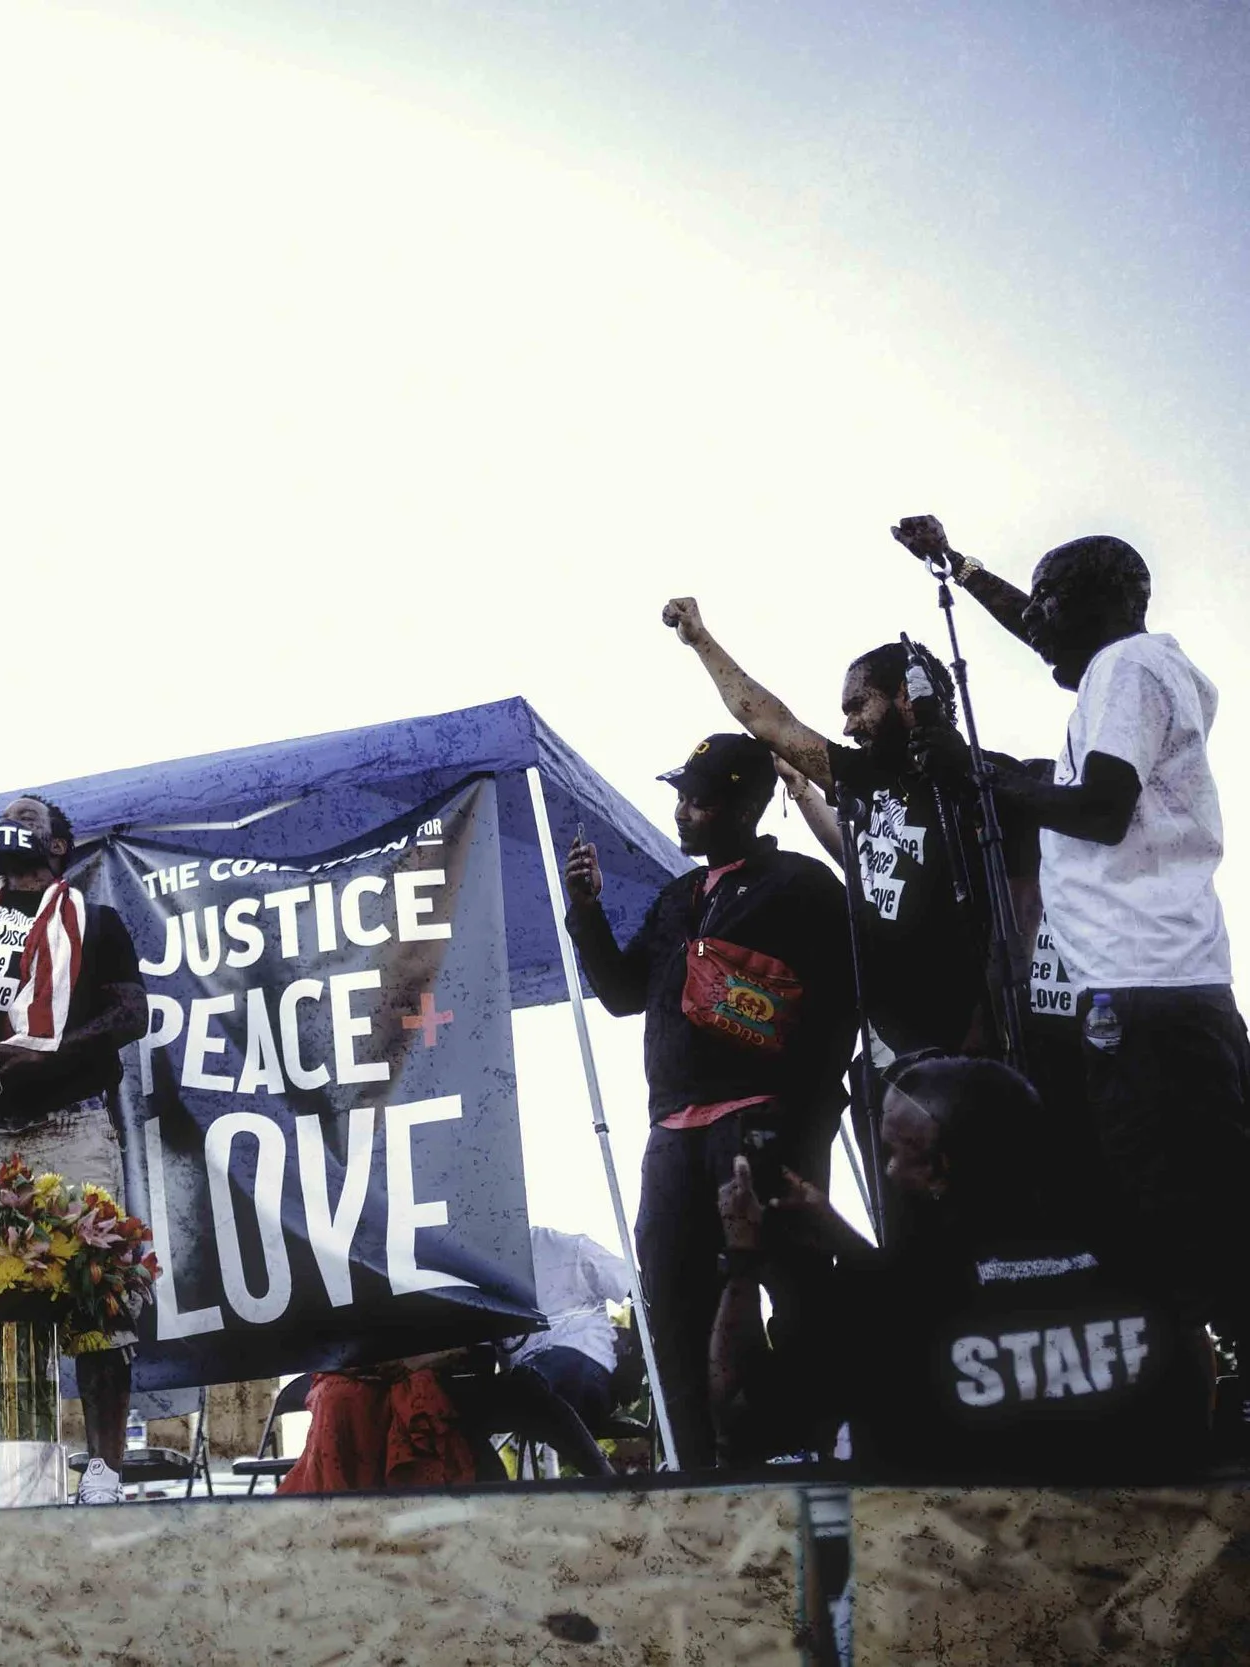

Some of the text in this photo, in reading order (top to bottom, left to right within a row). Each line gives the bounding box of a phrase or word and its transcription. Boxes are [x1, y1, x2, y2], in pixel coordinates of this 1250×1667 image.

[142, 861, 200, 898] THE
[416, 818, 443, 837] FOR
[139, 869, 452, 978] JUSTICE
[138, 970, 390, 1097] PEACE
[145, 1094, 479, 1340] LOVE
[952, 1316, 1149, 1407] STAFF
